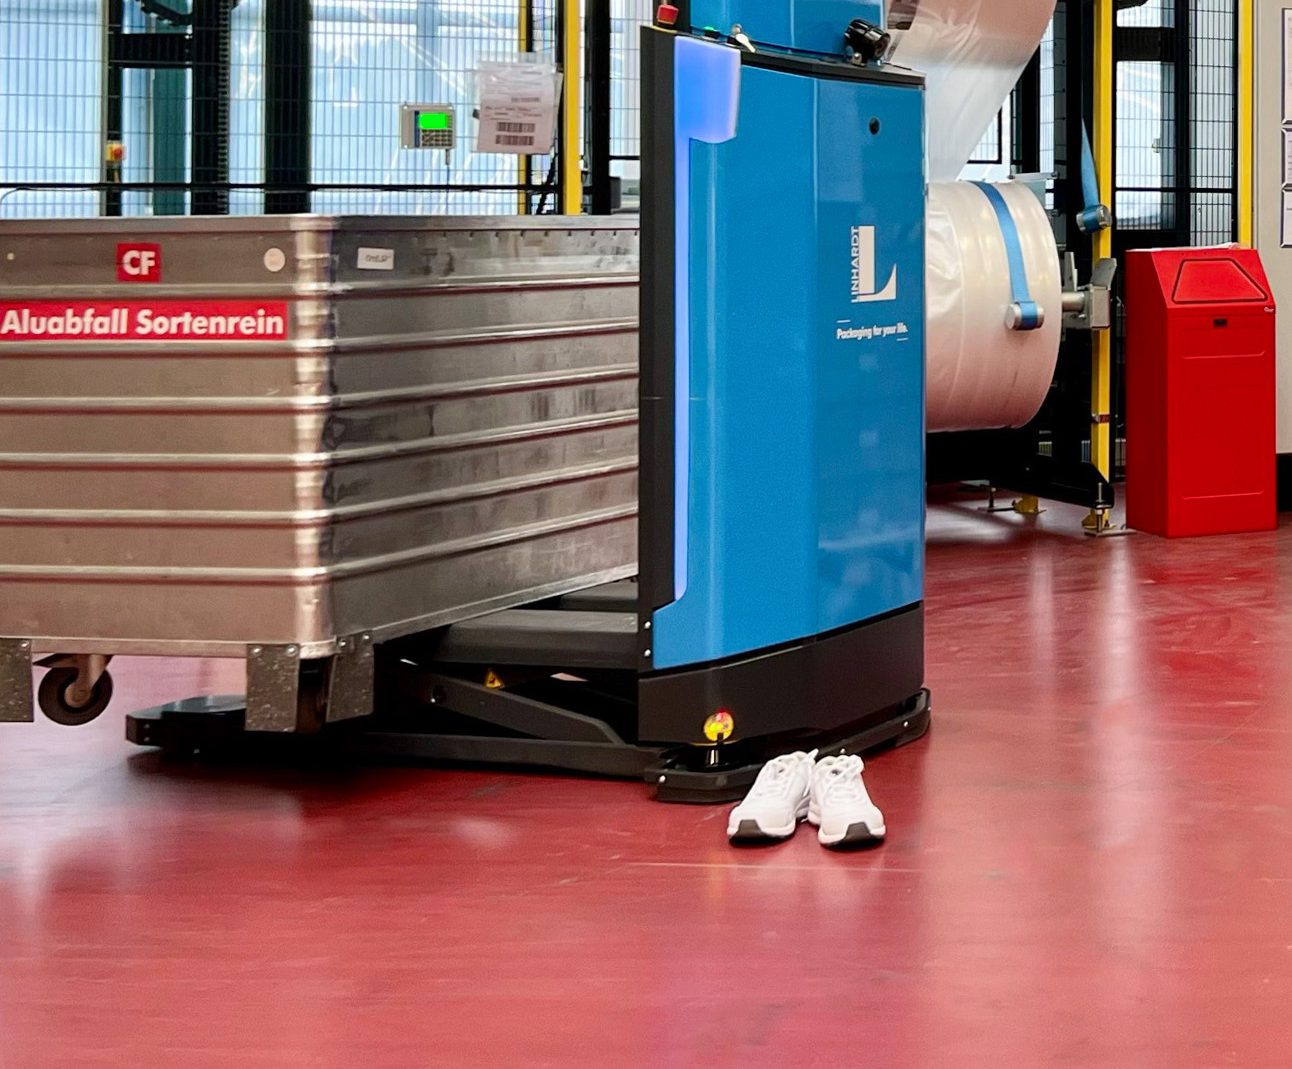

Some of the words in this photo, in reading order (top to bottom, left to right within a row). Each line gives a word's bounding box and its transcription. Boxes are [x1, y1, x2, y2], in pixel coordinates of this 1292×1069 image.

[121, 249, 156, 276] CF
[1, 307, 129, 335] Aluabfall
[136, 308, 284, 335] Sortenrein
[836, 326, 872, 340] Packaging
[873, 324, 883, 336] for
[882, 325, 897, 338] your
